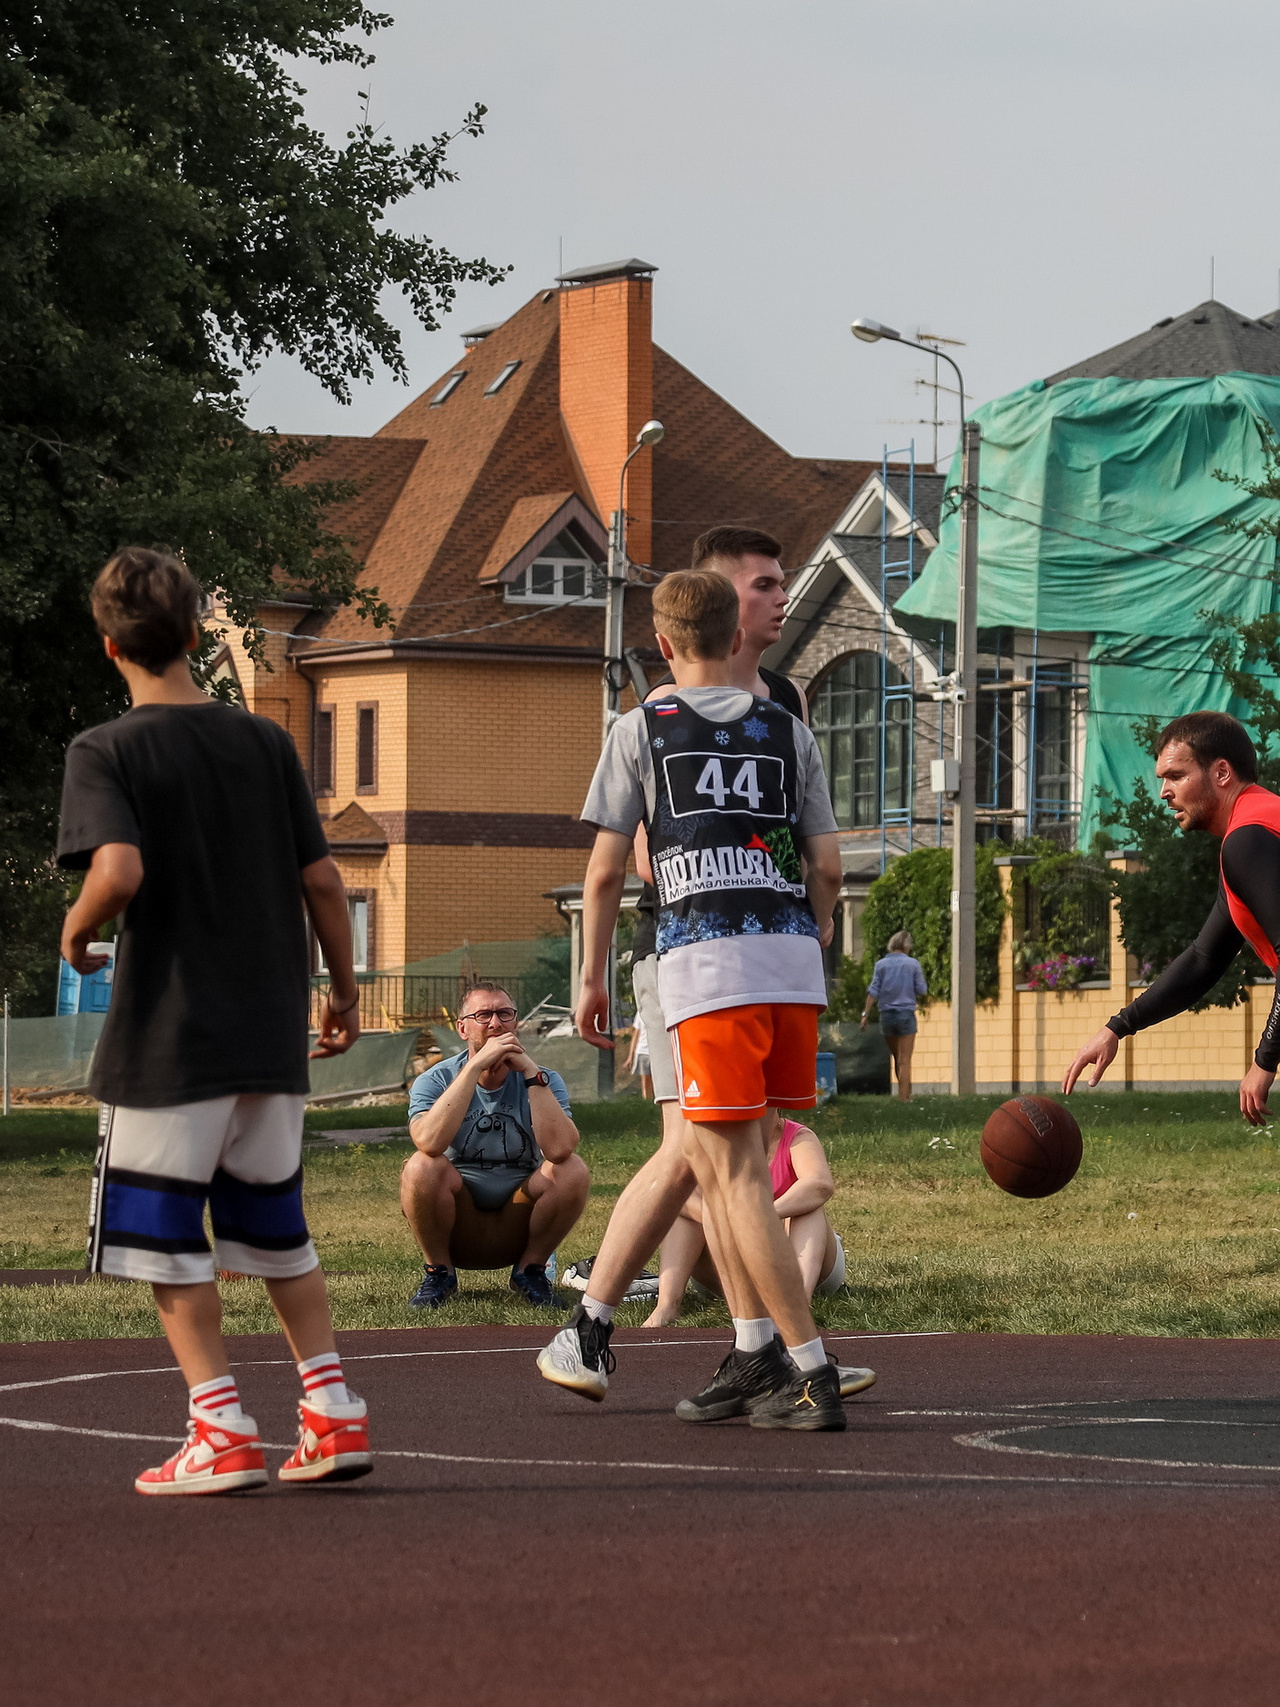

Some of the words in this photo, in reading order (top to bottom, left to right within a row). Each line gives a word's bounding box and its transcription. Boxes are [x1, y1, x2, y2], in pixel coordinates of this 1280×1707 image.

[695, 758, 764, 809] 44
[657, 844, 684, 861] посёлок
[670, 885, 690, 900] Моя
[694, 877, 769, 891] маленькая
